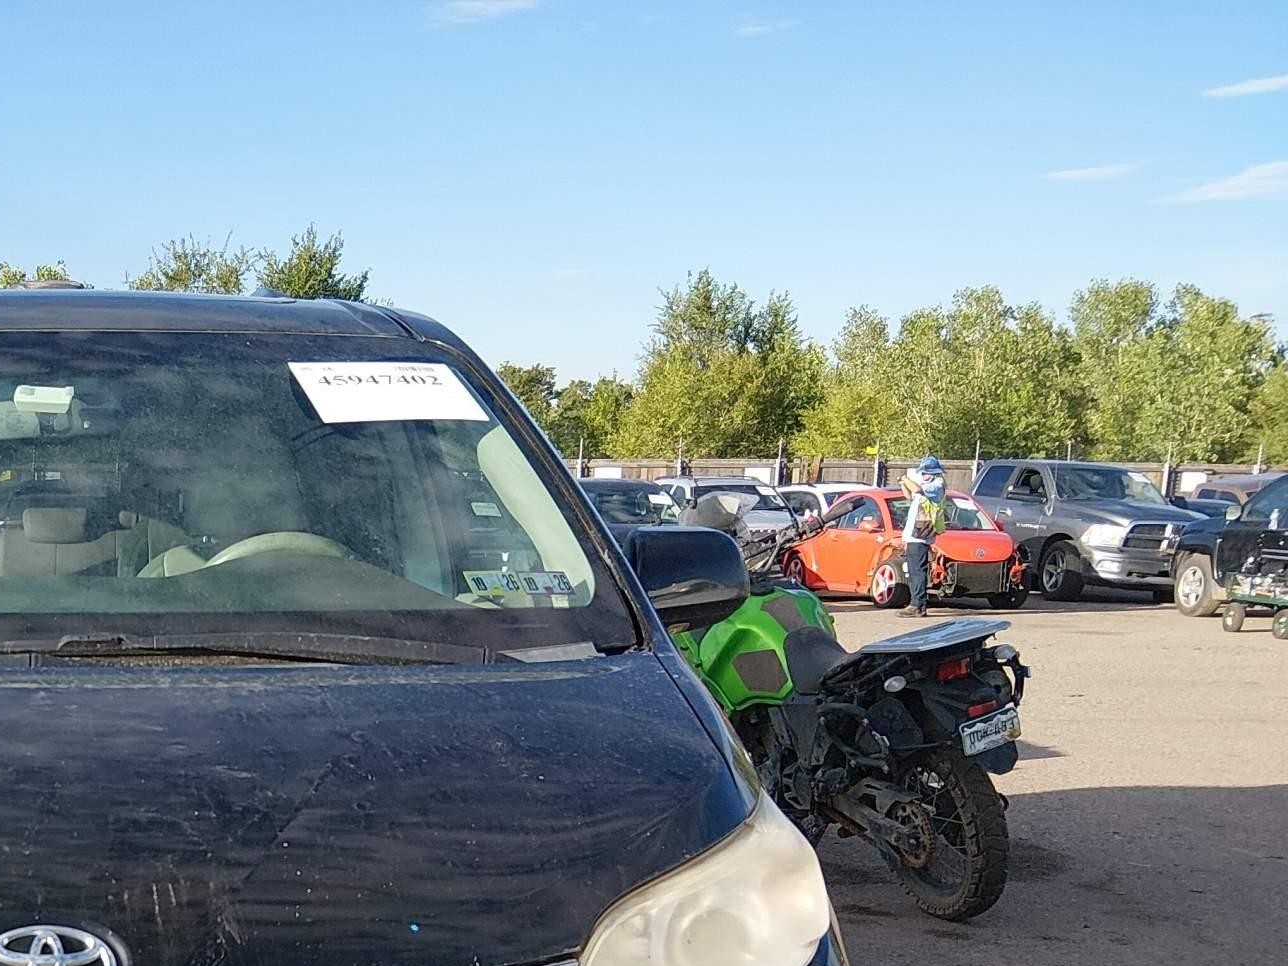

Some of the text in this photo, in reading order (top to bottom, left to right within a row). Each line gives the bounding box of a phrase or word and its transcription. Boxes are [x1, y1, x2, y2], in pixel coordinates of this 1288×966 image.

[317, 373, 444, 387] 45947402
[502, 574, 520, 592] 26
[553, 574, 572, 592] 26
